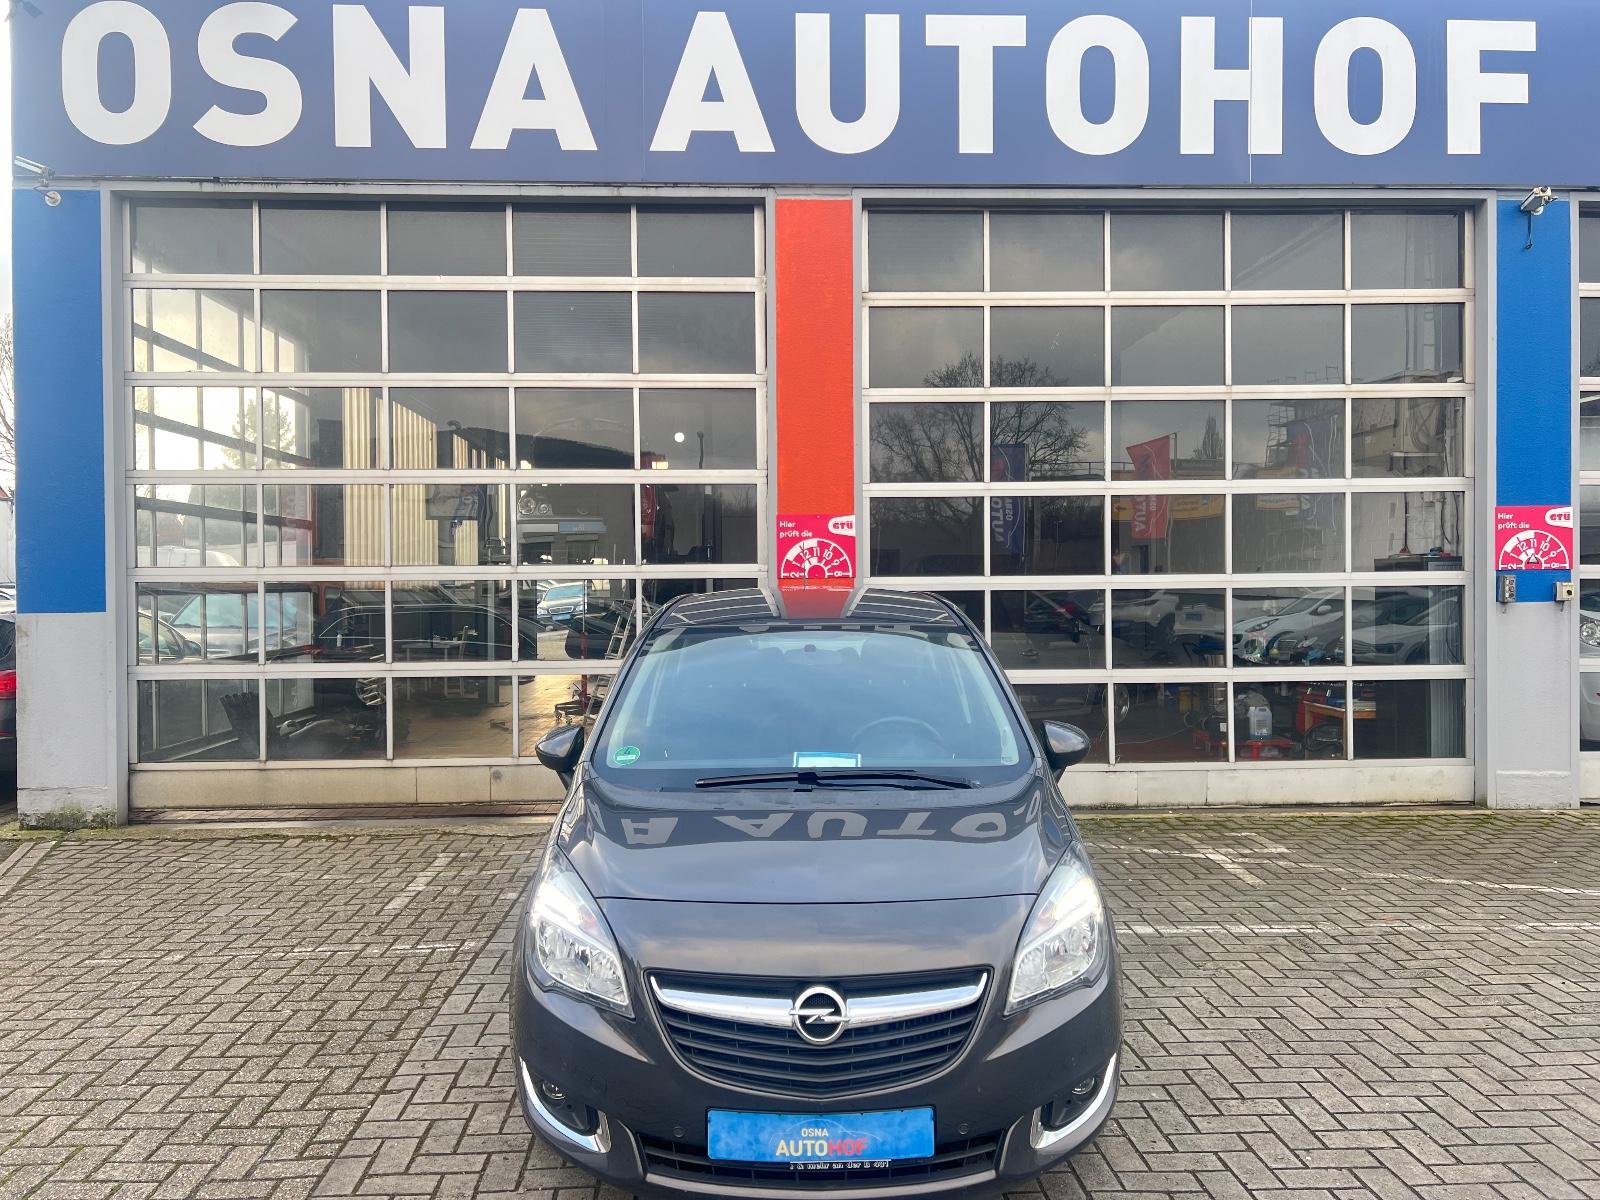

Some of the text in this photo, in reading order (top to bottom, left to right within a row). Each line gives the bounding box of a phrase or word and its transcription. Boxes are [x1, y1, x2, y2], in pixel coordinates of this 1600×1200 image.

[61, 0, 1538, 156] OSNA AUTOHOF
[1550, 513, 1570, 521] GTÜ
[833, 522, 853, 530] GTÜ
[1497, 521, 1518, 530] prüft
[779, 529, 799, 539] prüft
[1517, 541, 1528, 552] 12
[1530, 539, 1537, 548] 11
[1540, 540, 1550, 551] 10
[800, 550, 811, 559] 12
[813, 547, 820, 556] 11
[823, 549, 833, 560] 10
[801, 1128, 829, 1137] OSNA
[776, 1139, 868, 1157] AUTOHOF
